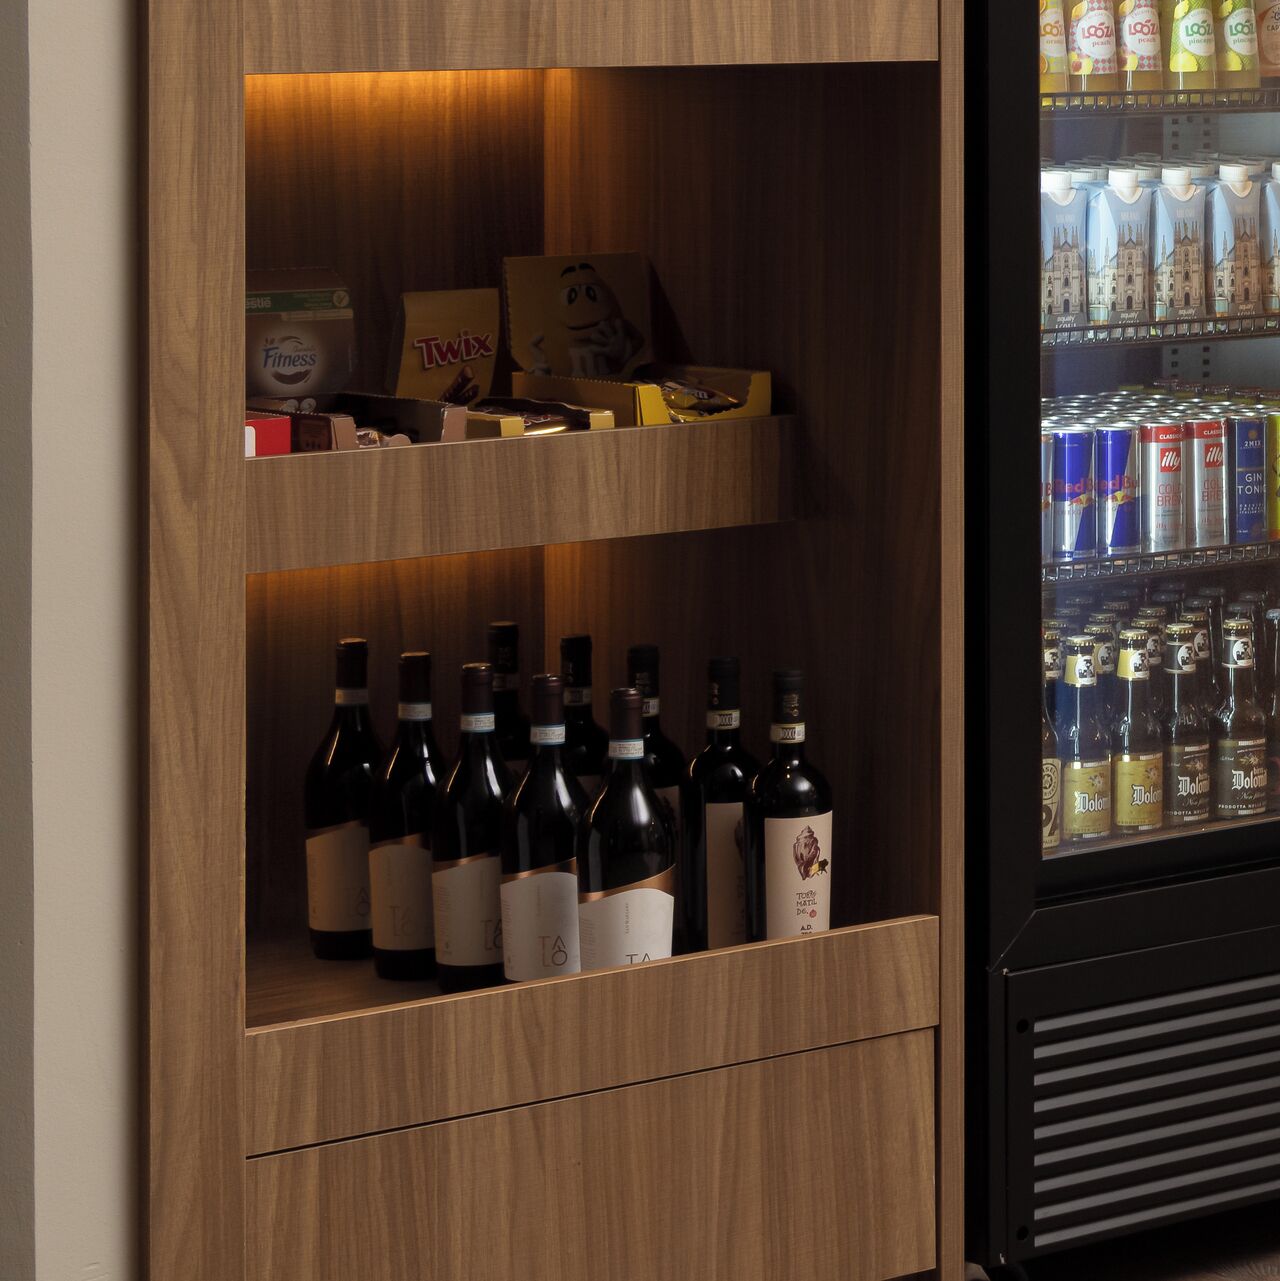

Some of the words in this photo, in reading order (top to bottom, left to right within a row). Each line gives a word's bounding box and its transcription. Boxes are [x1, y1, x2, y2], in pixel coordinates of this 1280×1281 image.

[262, 346, 318, 369] Fitness
[414, 328, 494, 370] Twix
[1162, 450, 1181, 471] illy
[1245, 473, 1263, 483] GIN
